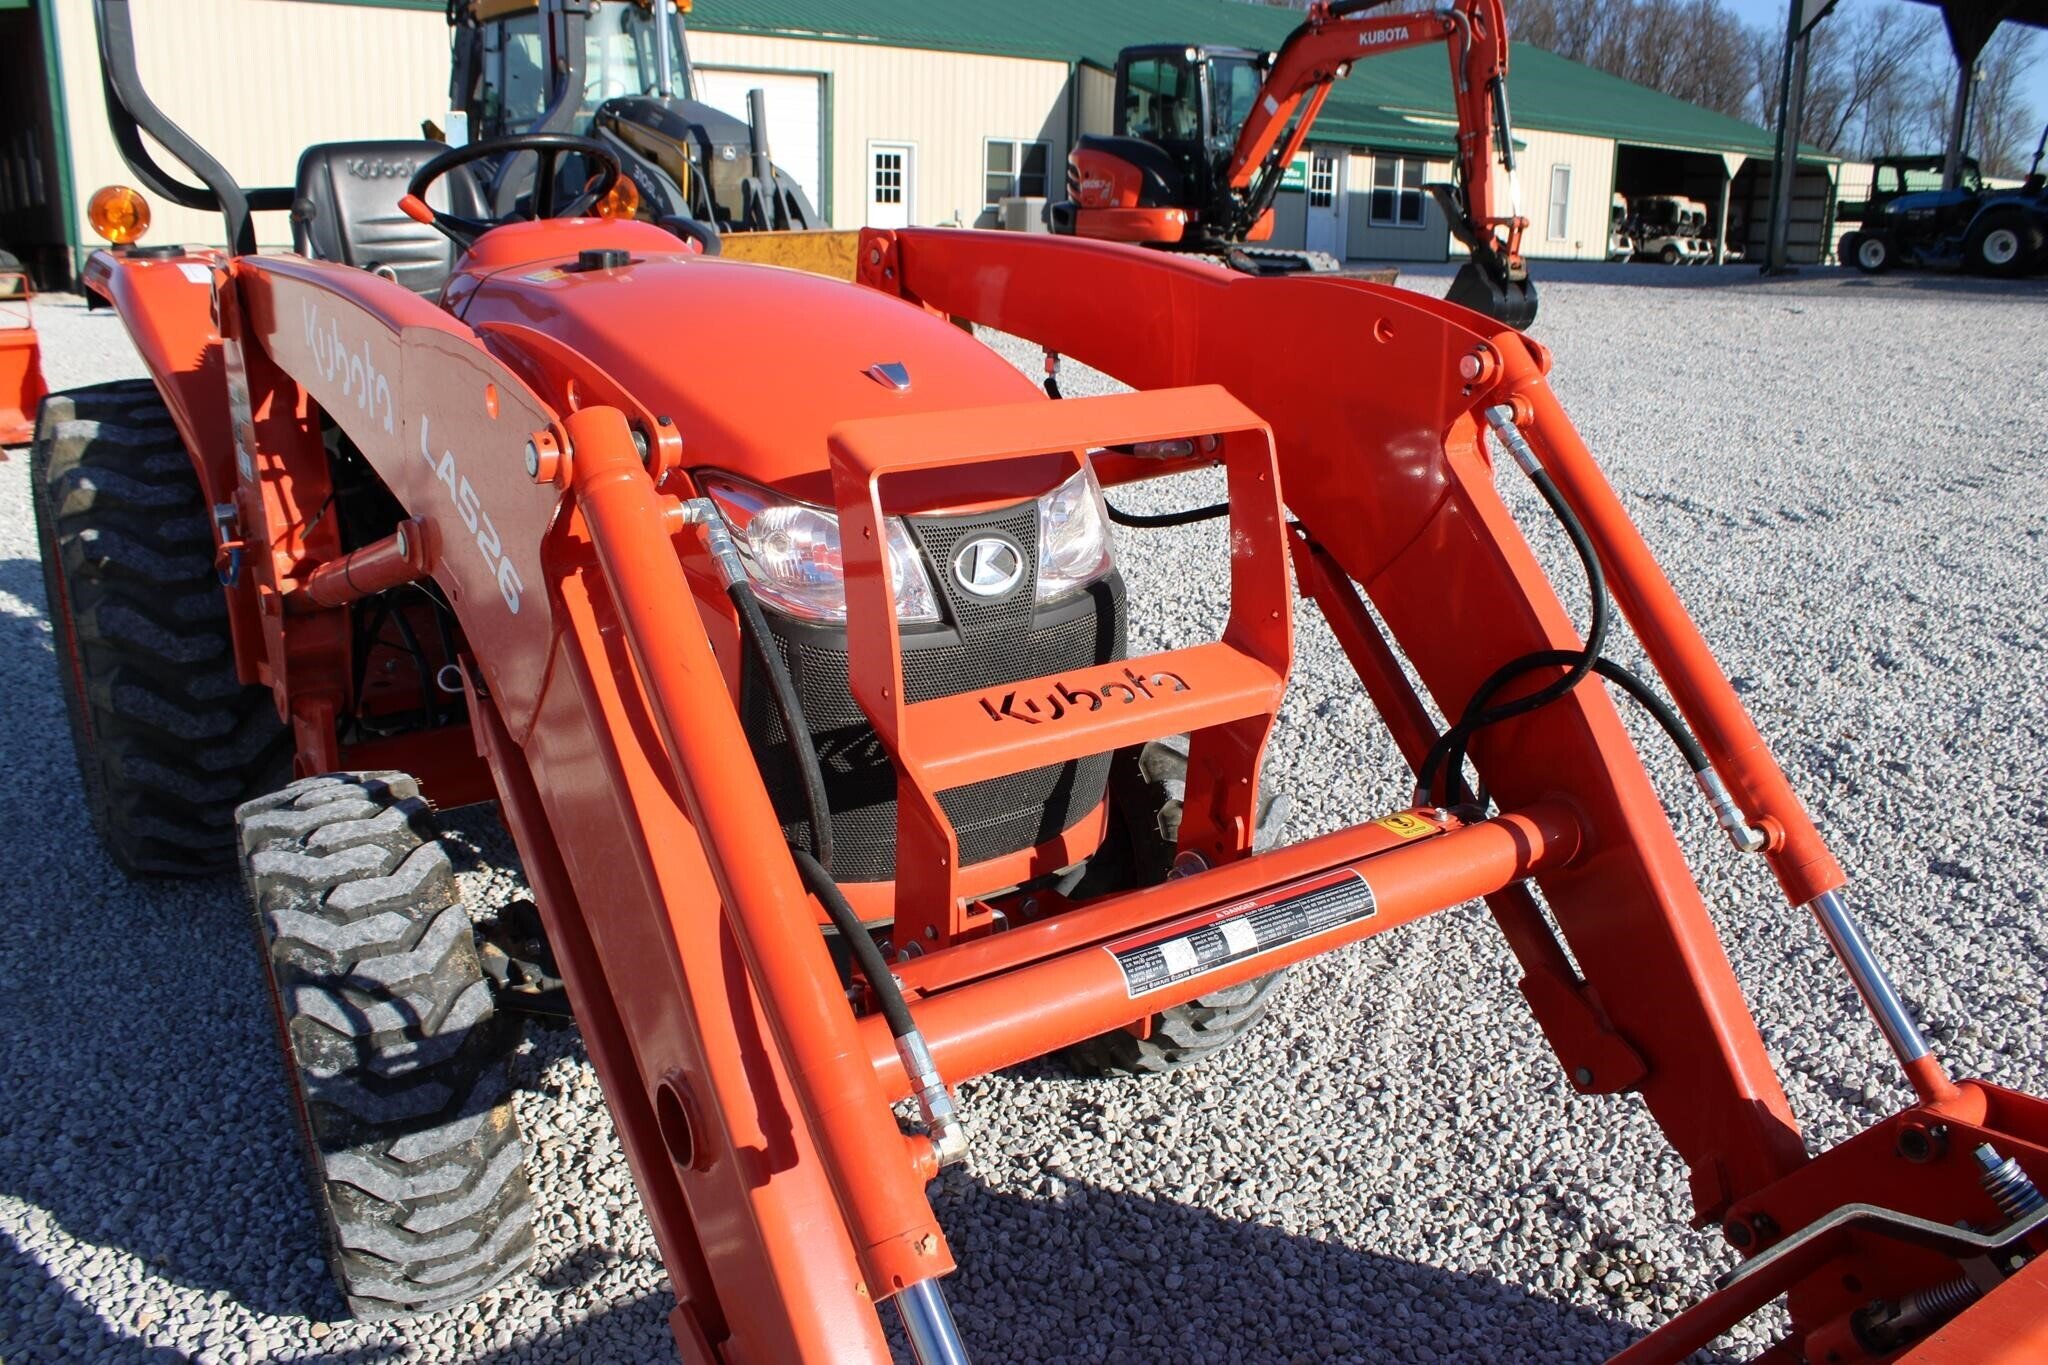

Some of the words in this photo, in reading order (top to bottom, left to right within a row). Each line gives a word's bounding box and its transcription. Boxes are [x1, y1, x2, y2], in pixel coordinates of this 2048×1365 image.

[1359, 26, 1409, 46] KUBOTA
[347, 158, 416, 179] Kubot
[302, 295, 395, 436] Kubota
[420, 414, 524, 616] LA526
[978, 667, 1191, 725] Kubota
[1222, 901, 1257, 915] DANGER
